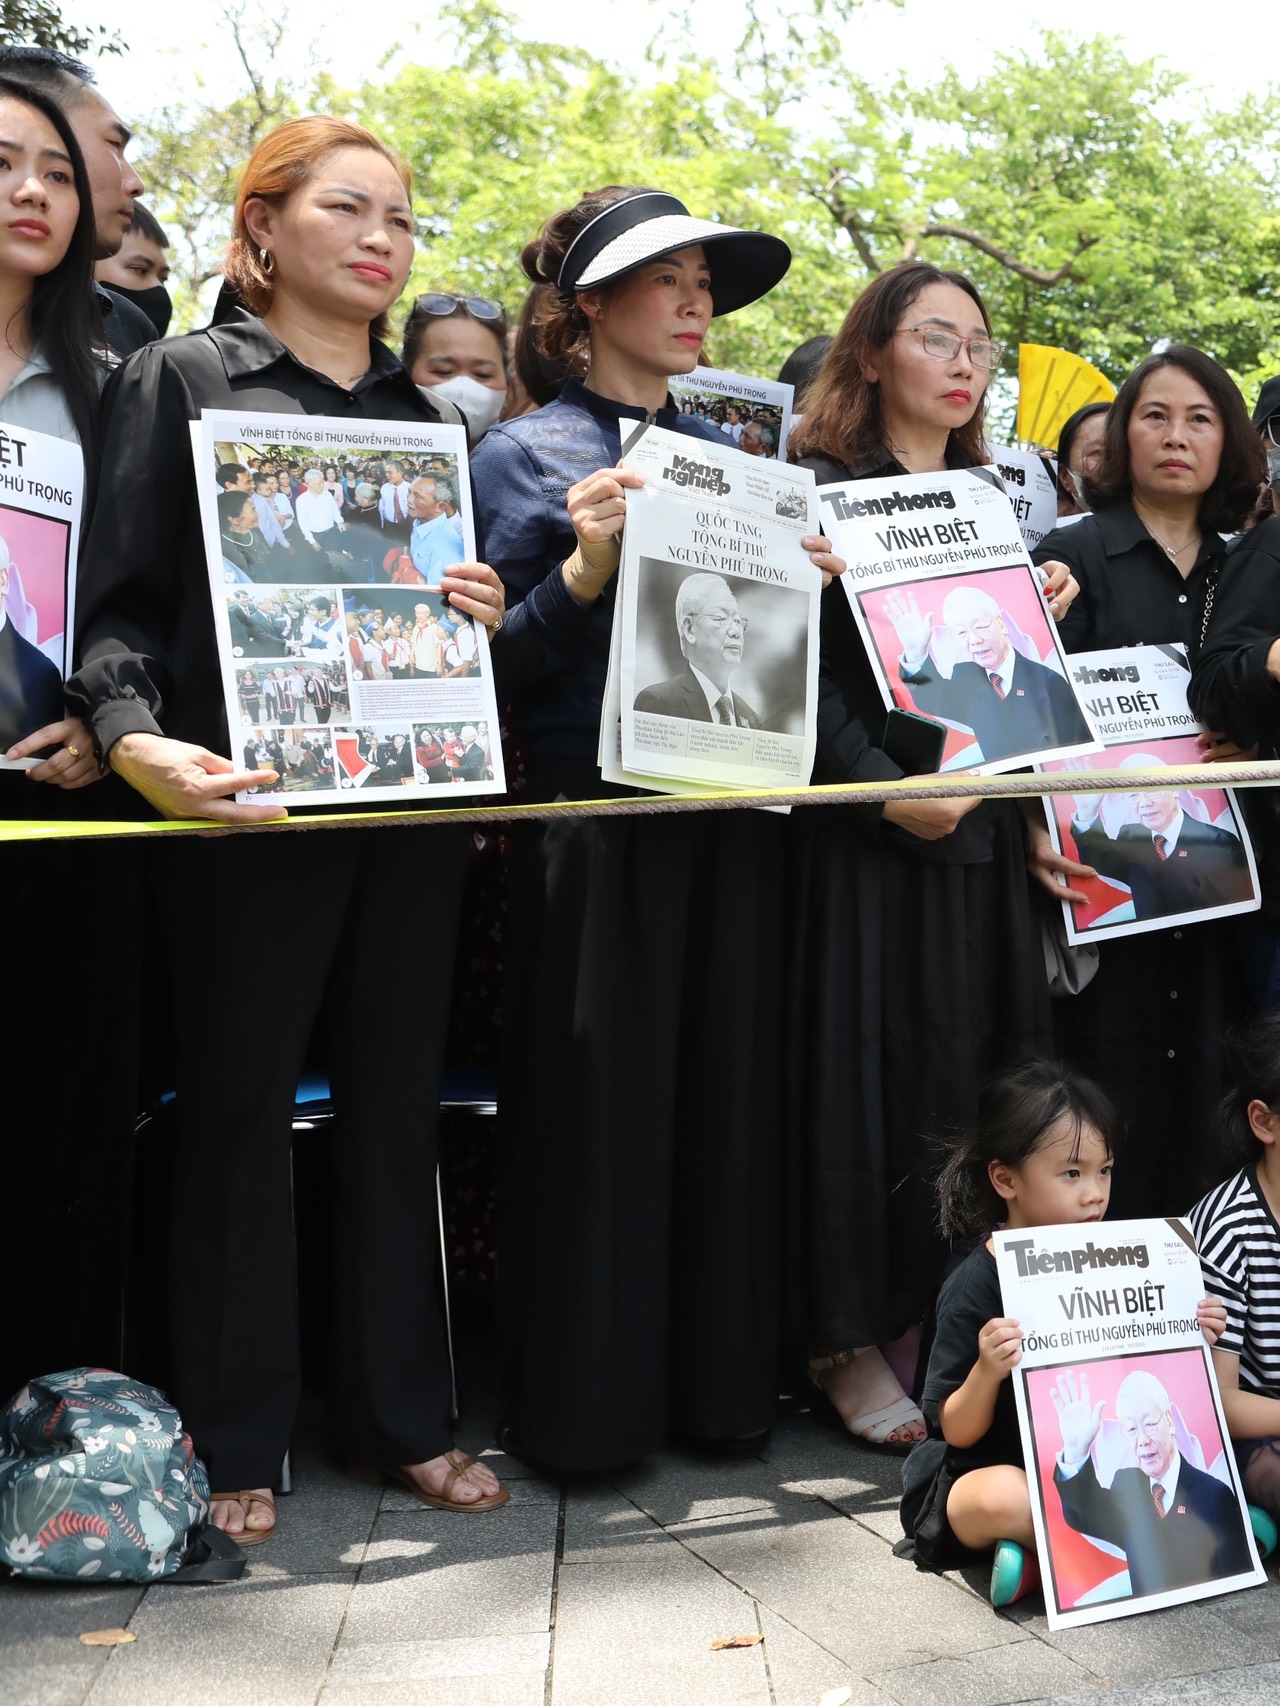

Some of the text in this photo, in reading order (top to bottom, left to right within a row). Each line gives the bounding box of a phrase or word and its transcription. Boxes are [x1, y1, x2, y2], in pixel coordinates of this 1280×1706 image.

[0, 430, 26, 468] ỆT
[240, 426, 433, 447] VĨNH BIỆT TỔNG BÍ THƯ NGUYỄN PHÚ TRỌNG
[27, 480, 72, 505] TRỌNG
[696, 509, 731, 530] QUỐC
[733, 520, 762, 539] TANG
[875, 518, 981, 552] VĨNH BIỆT
[692, 526, 768, 558] TỔNG BÍ THƯ
[667, 545, 788, 582] NGUYỄN PHÚ TRỌNG
[848, 542, 1022, 580] TỔNG BÍ THƯ NGUYỄN PHÚ TRỌNG
[1117, 690, 1160, 715] BIỆT
[1100, 717, 1142, 734] NGUYỄN
[1144, 715, 1165, 729] PHÚ
[1058, 1279, 1165, 1320] VĨNH BIỆT
[1021, 1318, 1200, 1352] TỔNG BÍ THƯ NGUYỄN PHÚ TRỌNG
